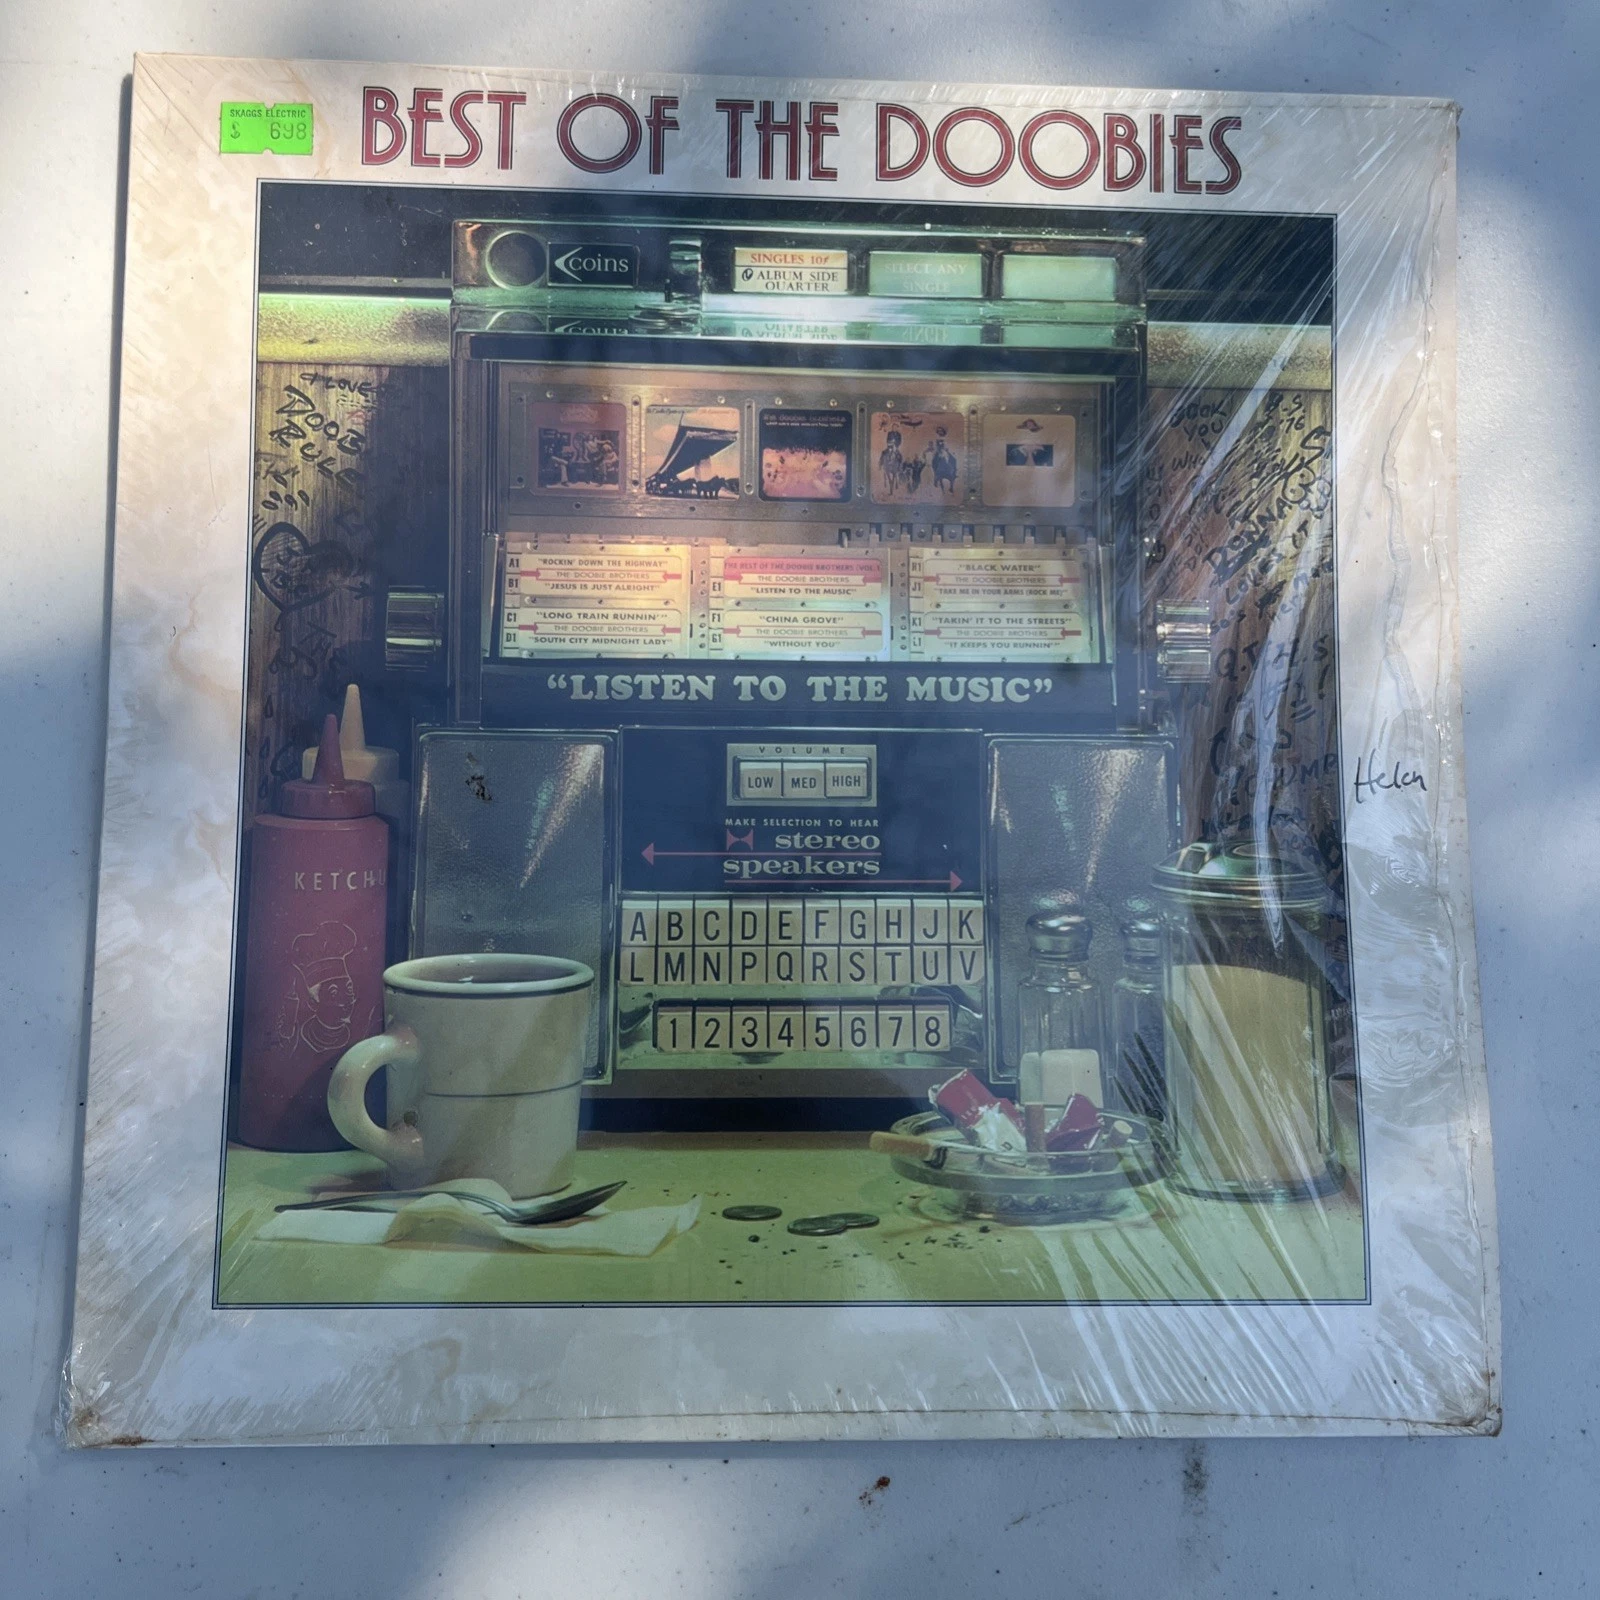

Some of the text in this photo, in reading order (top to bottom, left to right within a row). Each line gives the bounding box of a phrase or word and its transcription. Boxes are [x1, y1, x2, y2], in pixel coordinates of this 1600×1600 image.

[230, 109, 306, 118] SKAGGS ELECTRIC
[270, 122, 306, 140] 698
[362, 86, 1242, 195] BEST OF THE DOOBIES
[569, 253, 629, 272] coins
[751, 254, 804, 265] SINGLES
[885, 264, 967, 275] SELECT ANY
[757, 271, 838, 282] ALBUM SIDE
[765, 282, 830, 292] QUARTER
[509, 558, 519, 568] A1
[508, 578, 518, 588] B1
[712, 582, 721, 592] E1
[912, 582, 921, 592] J1
[507, 612, 517, 622] C1
[712, 613, 721, 623] F1
[912, 617, 922, 626] K1
[506, 633, 516, 642] D1
[548, 674, 1053, 703] "LISTEN TO THE MUSIC"
[759, 746, 845, 754] VOLUME
[1354, 748, 1427, 804] Helen
[748, 776, 861, 789] LOW MED HIGH
[725, 818, 756, 826] MAKE
[764, 819, 821, 827] SELECTION
[828, 819, 842, 827] TO
[775, 832, 880, 849] stereo
[723, 856, 880, 879] speakers
[630, 909, 974, 942] A B C D E F G H J K
[630, 951, 976, 982] L M N P Q R S T U V
[669, 1016, 940, 1048] 1 2 3 4 5 6 7 8
